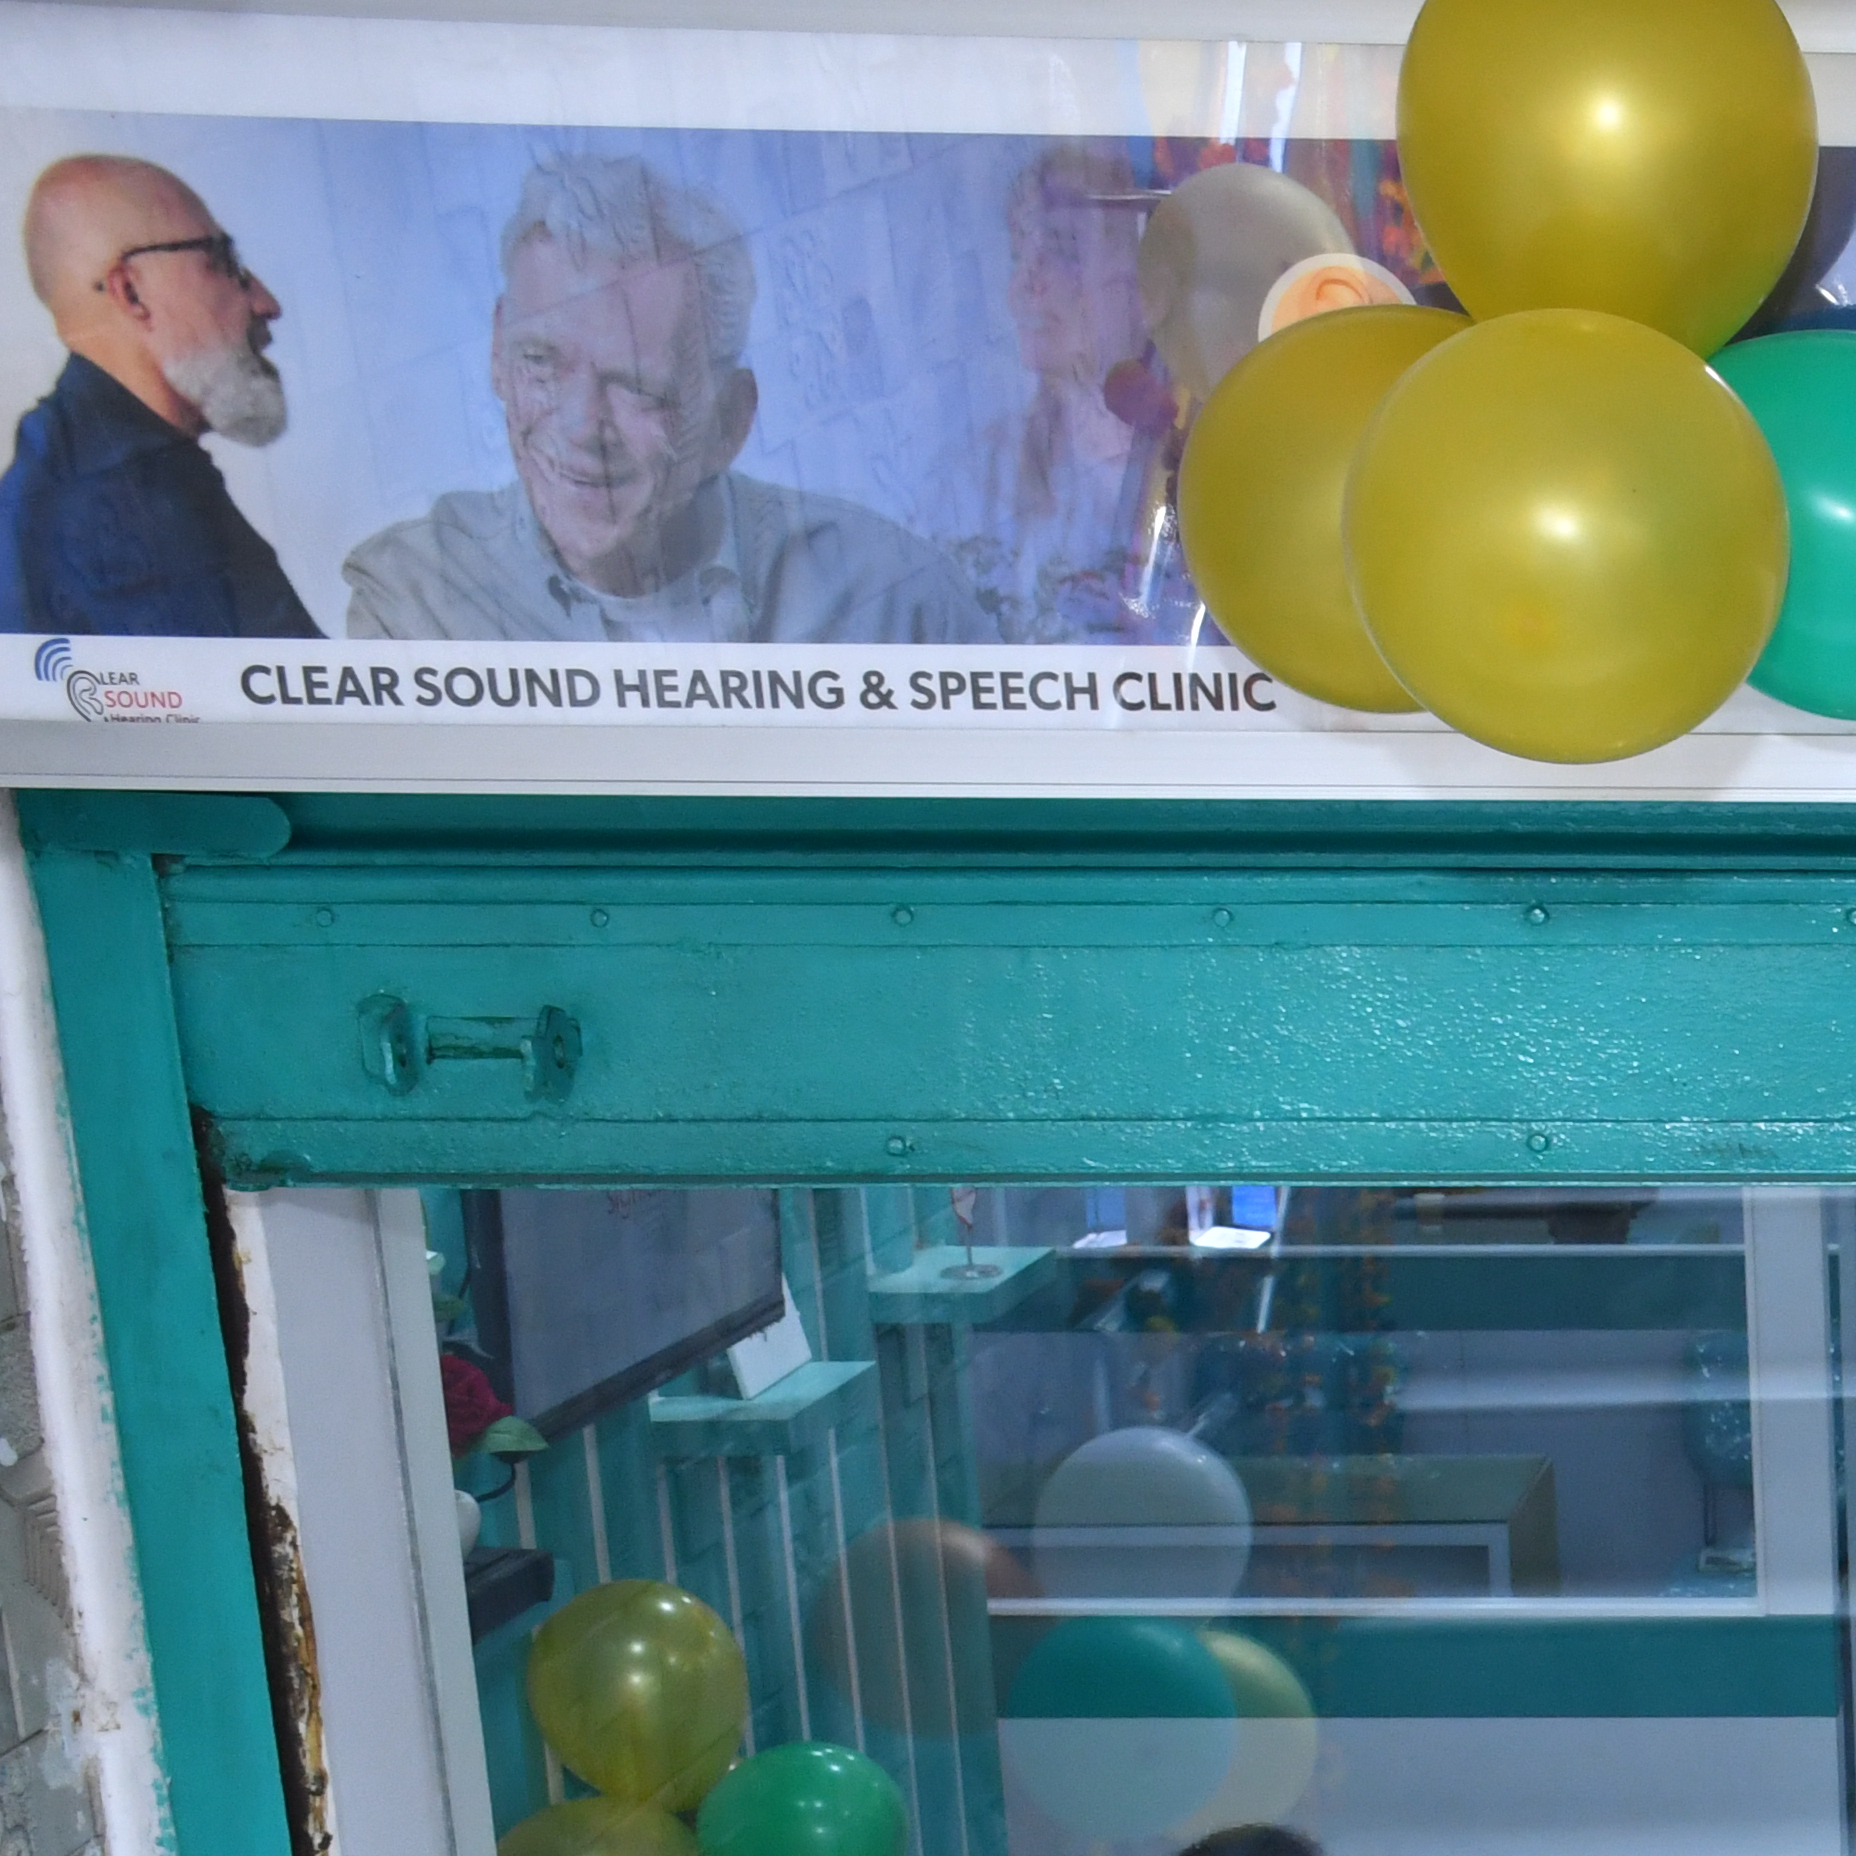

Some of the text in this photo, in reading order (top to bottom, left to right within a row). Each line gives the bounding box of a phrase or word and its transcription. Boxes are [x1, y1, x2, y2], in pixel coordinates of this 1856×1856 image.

[104, 690, 182, 709] SOUND
[240, 664, 1277, 712] CLEAR SOUND HEARING & SPEECH CLINIC
